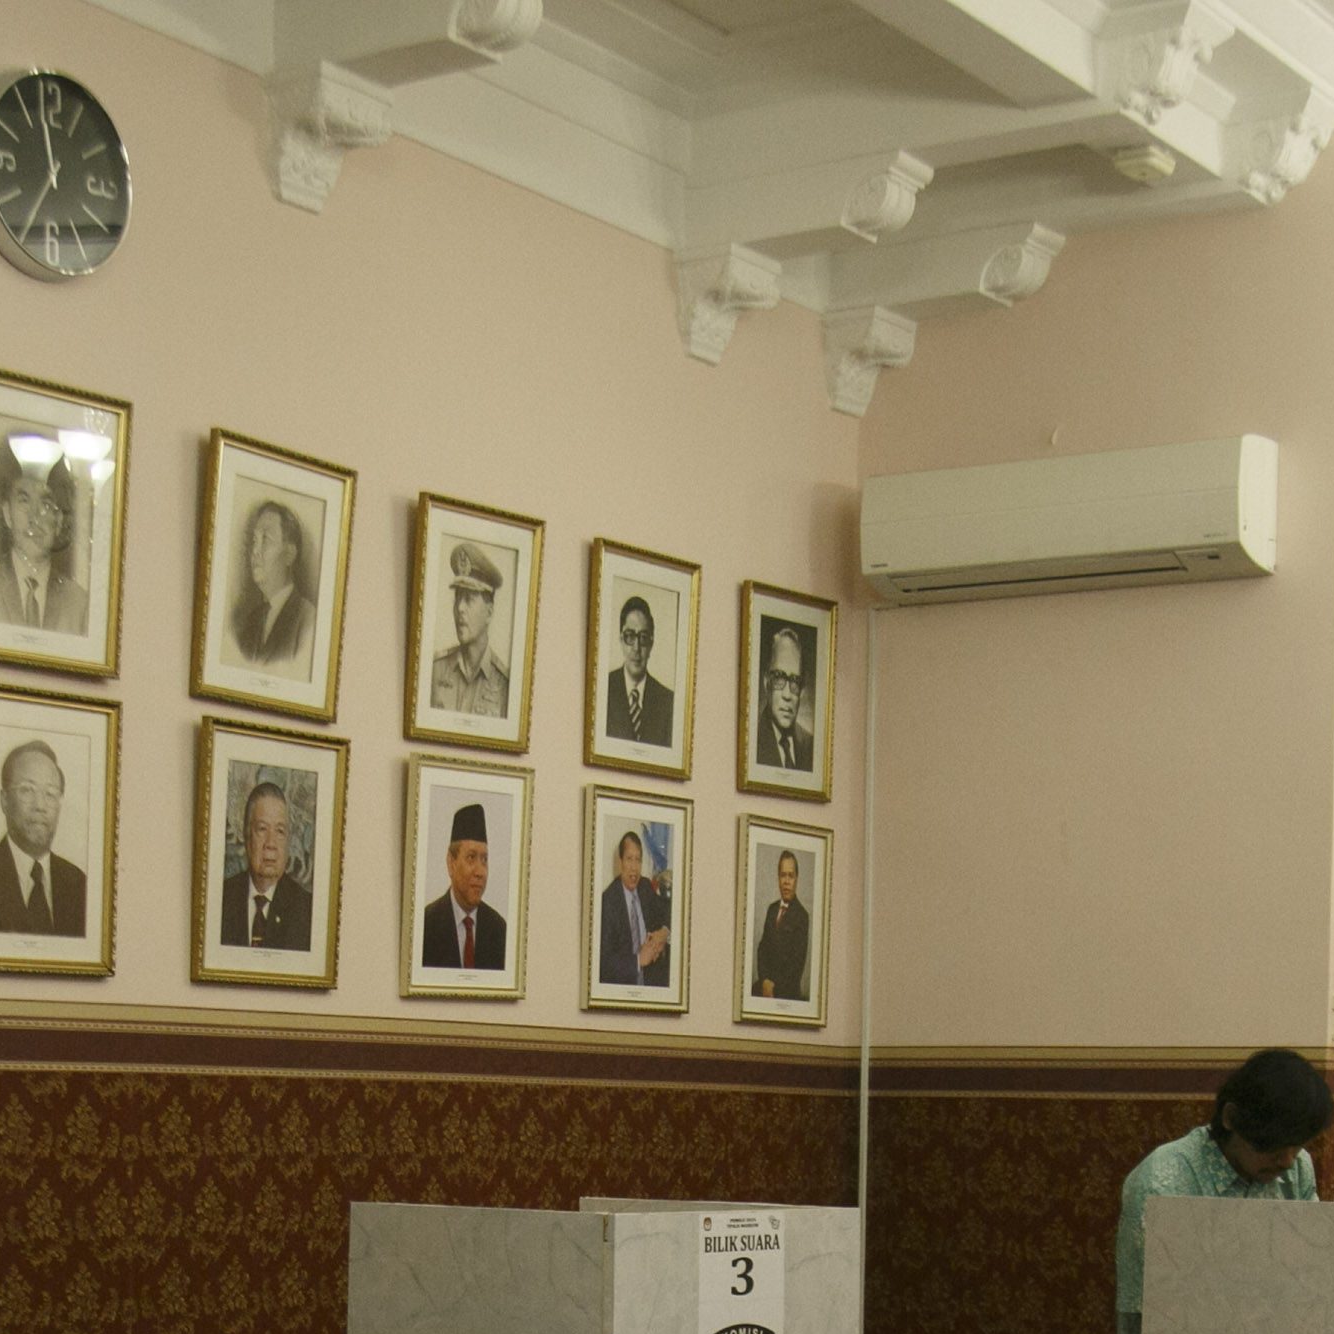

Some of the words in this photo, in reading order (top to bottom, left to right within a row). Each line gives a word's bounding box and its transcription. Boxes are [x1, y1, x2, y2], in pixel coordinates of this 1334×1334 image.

[704, 1236, 738, 1253] BILIK
[740, 1234, 780, 1251] SUARA
[731, 1256, 754, 1296] 3
